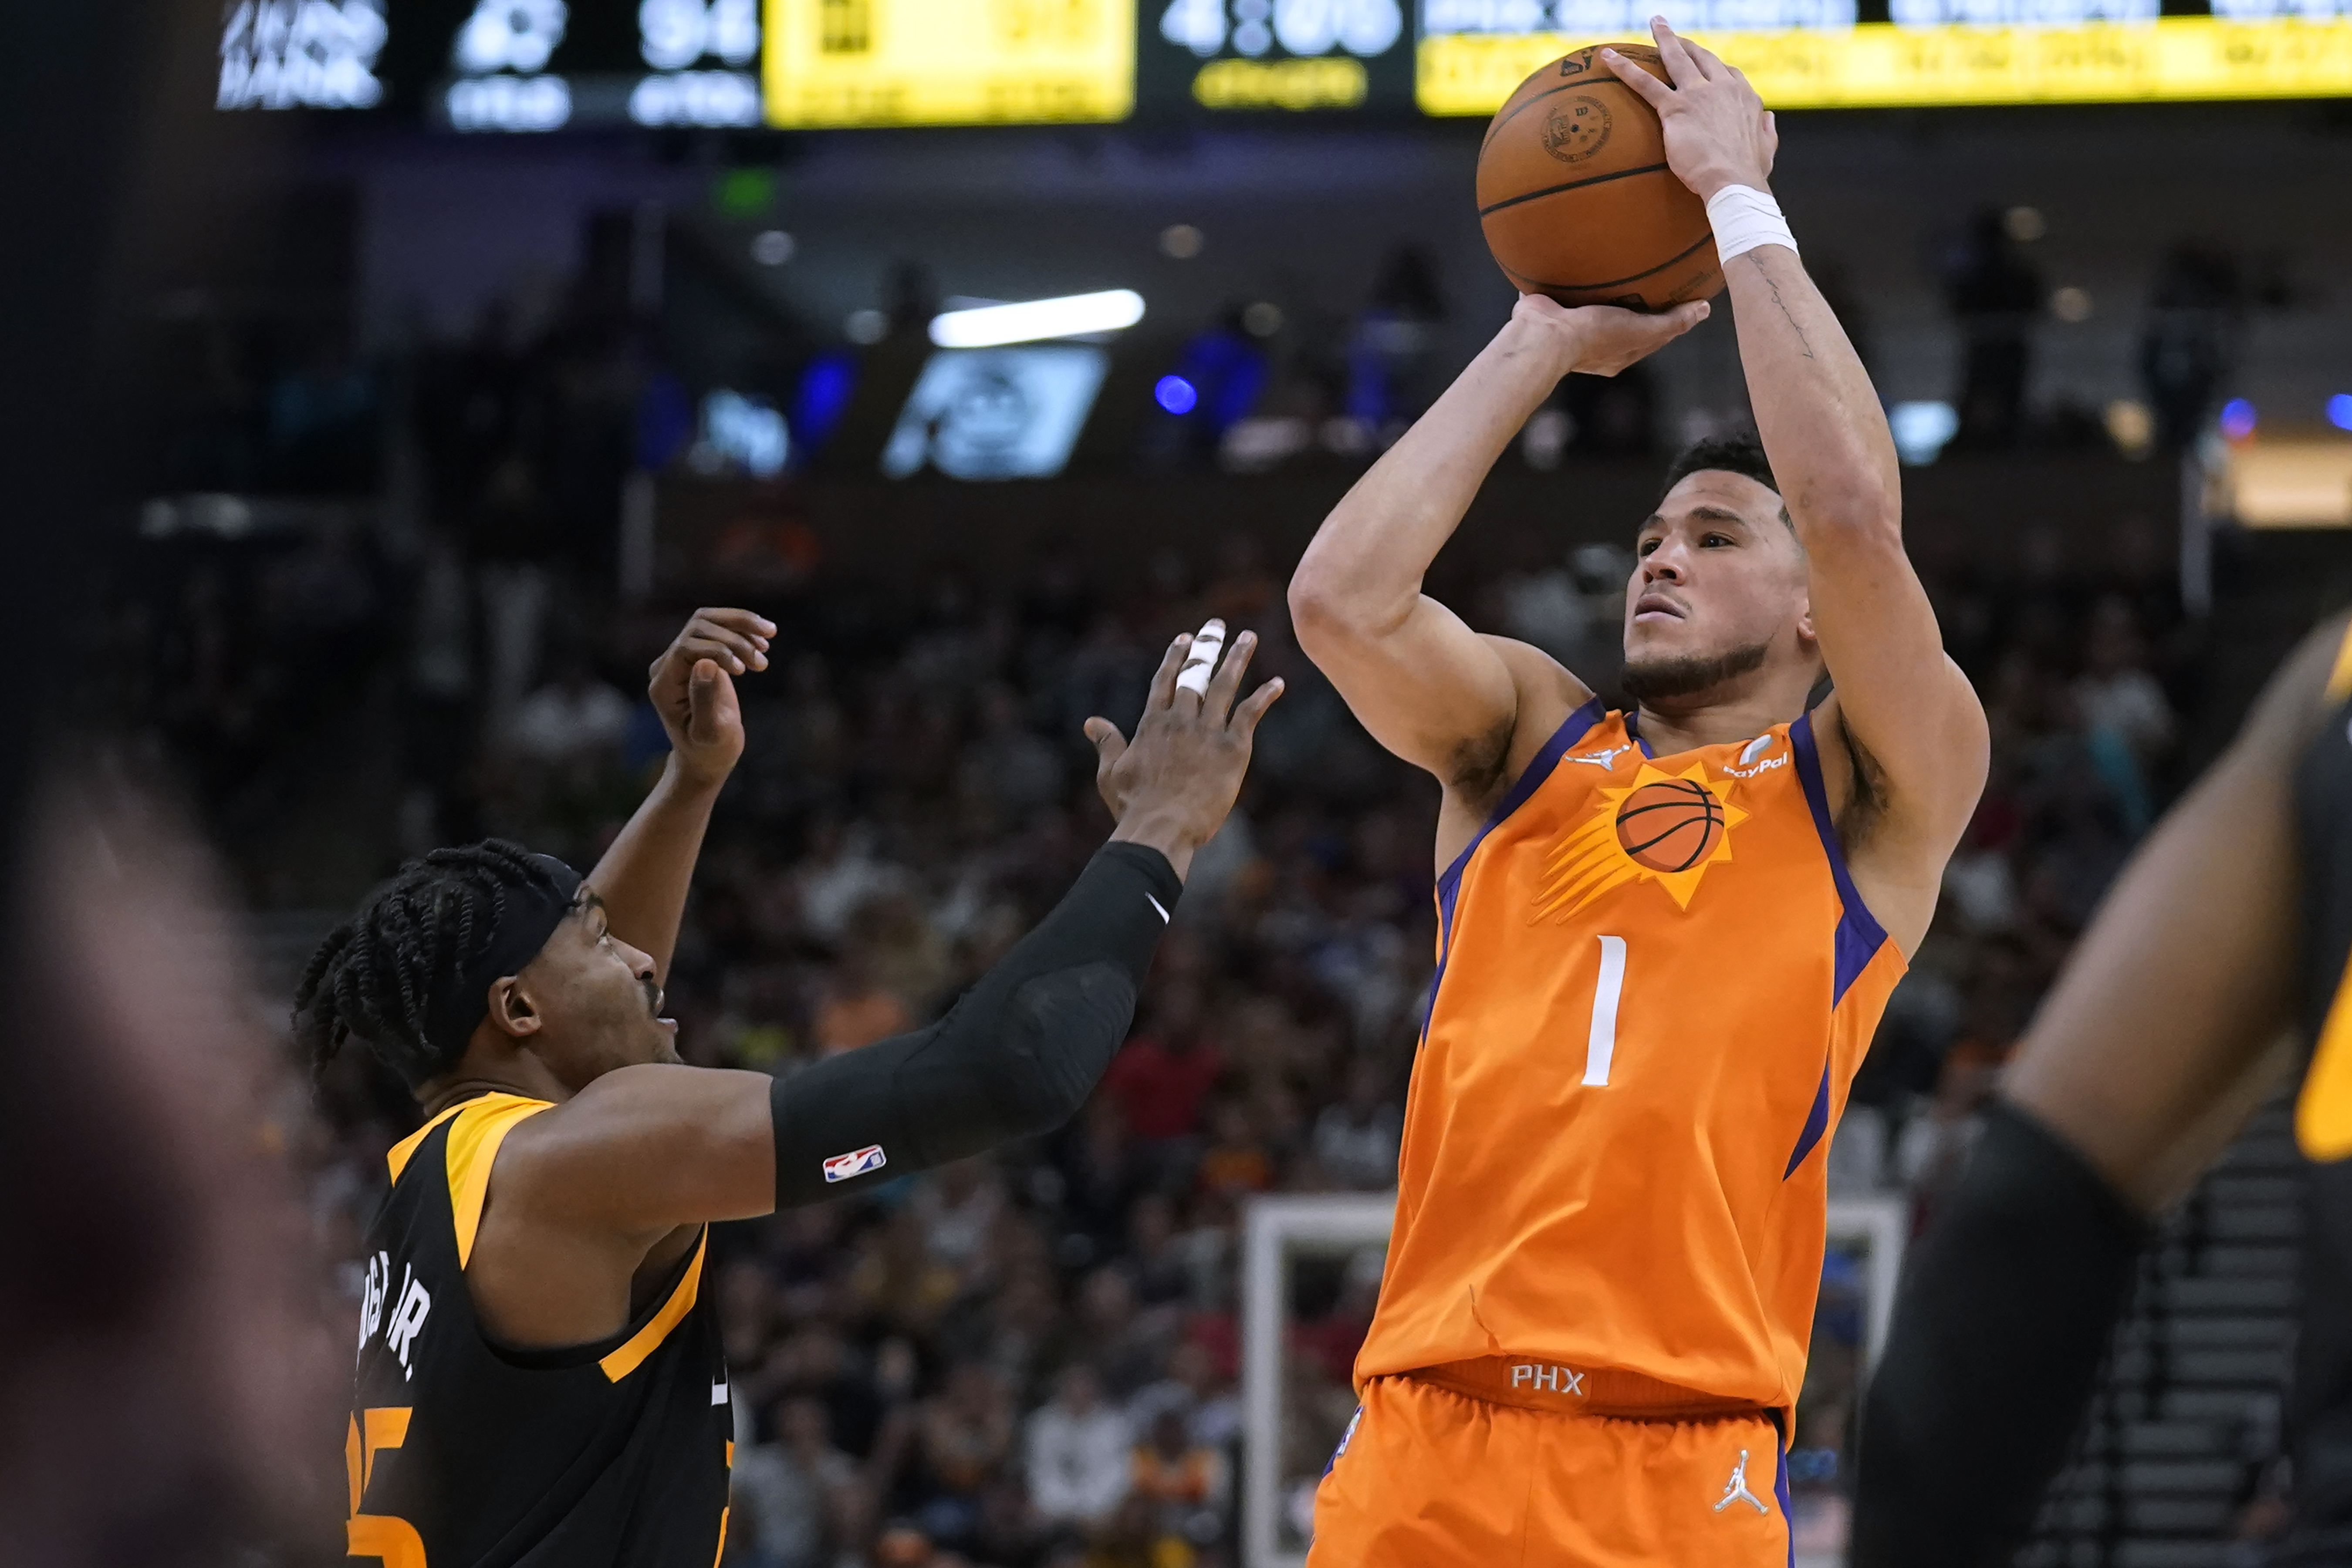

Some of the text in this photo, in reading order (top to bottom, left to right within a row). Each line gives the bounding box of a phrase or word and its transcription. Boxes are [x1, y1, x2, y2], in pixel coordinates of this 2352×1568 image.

[1723, 751, 1788, 778] PayPal
[1581, 934, 1627, 1086] 1
[1511, 1364, 1585, 1396] PHX
